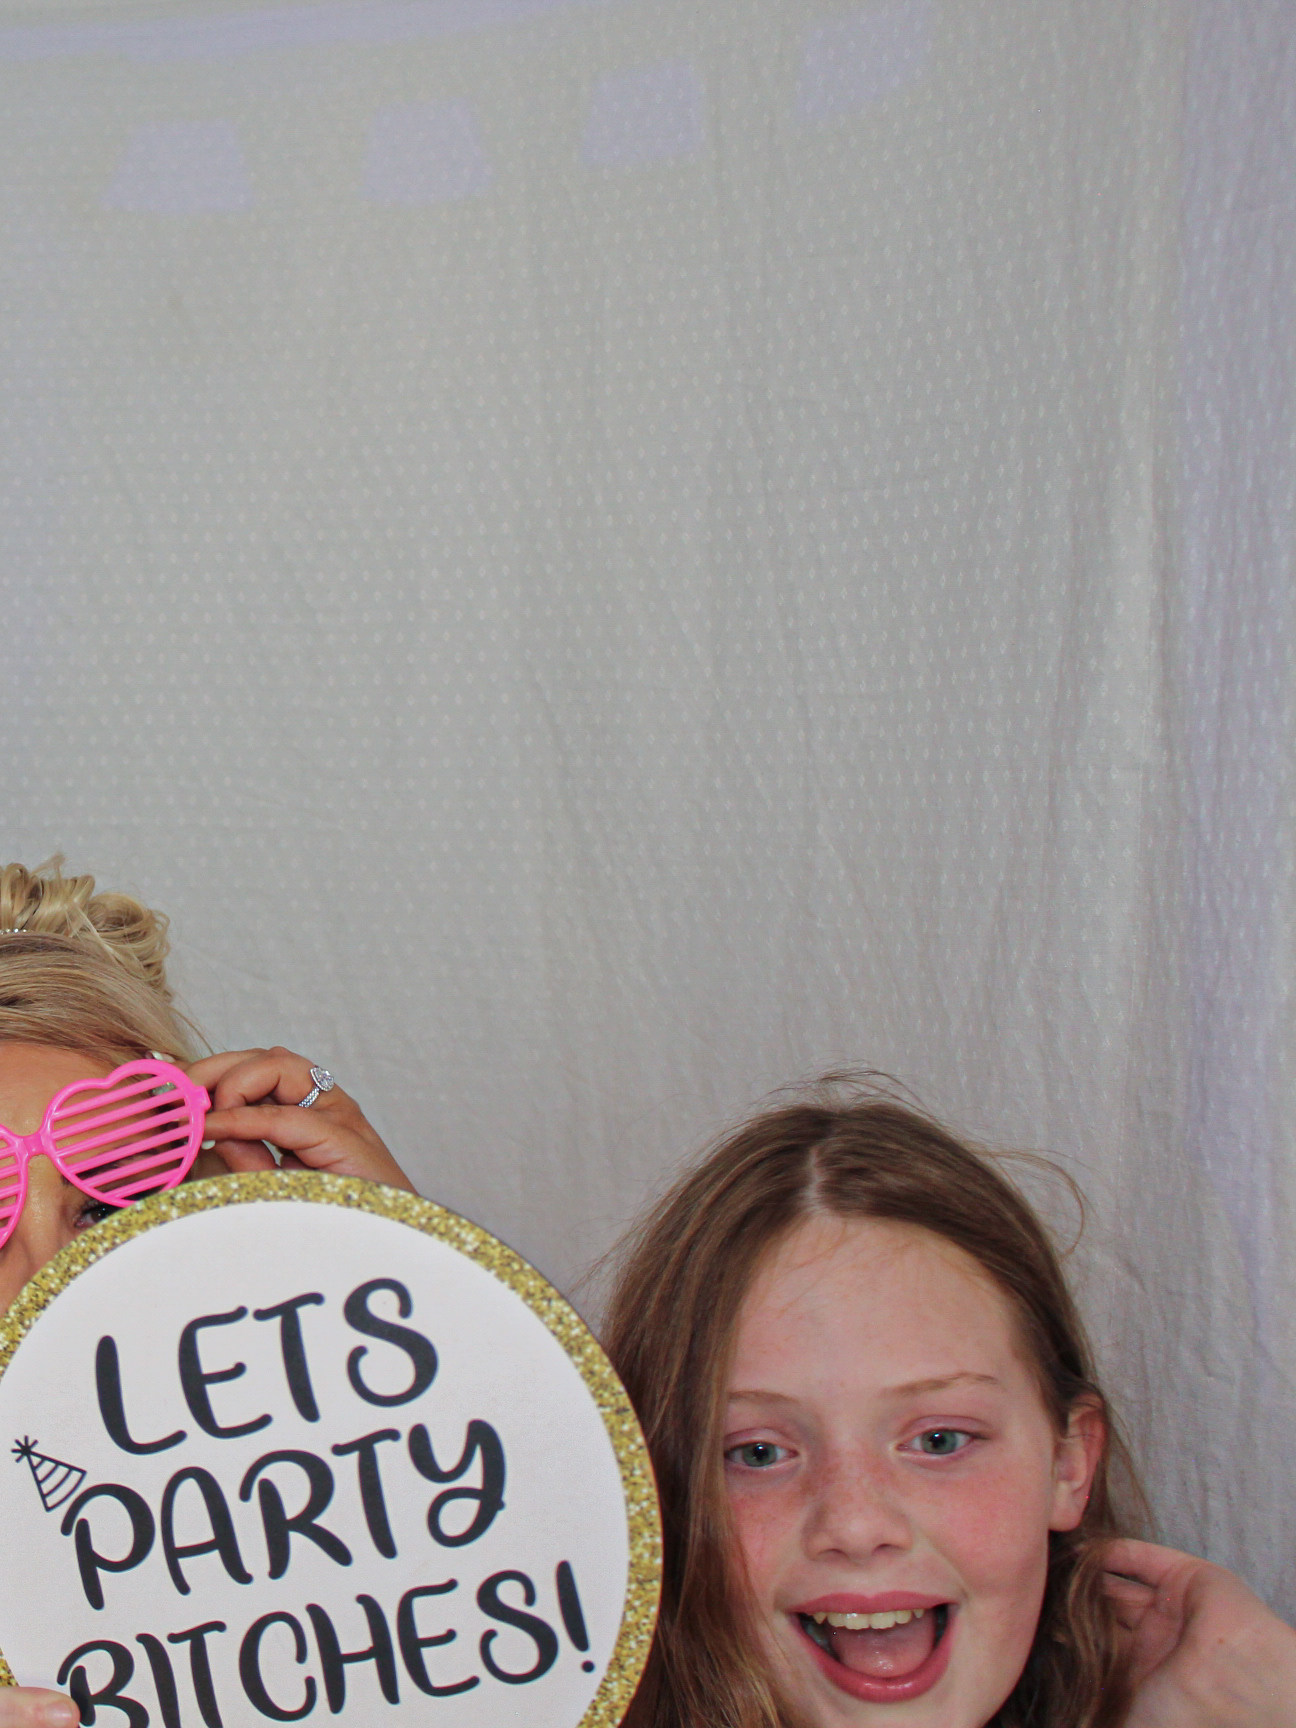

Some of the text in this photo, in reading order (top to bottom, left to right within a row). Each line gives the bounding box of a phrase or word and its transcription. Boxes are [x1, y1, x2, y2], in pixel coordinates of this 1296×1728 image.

[95, 1278, 438, 1455] LETS
[60, 1419, 506, 1611] PARTY
[56, 1560, 596, 1728] BITCHES!
